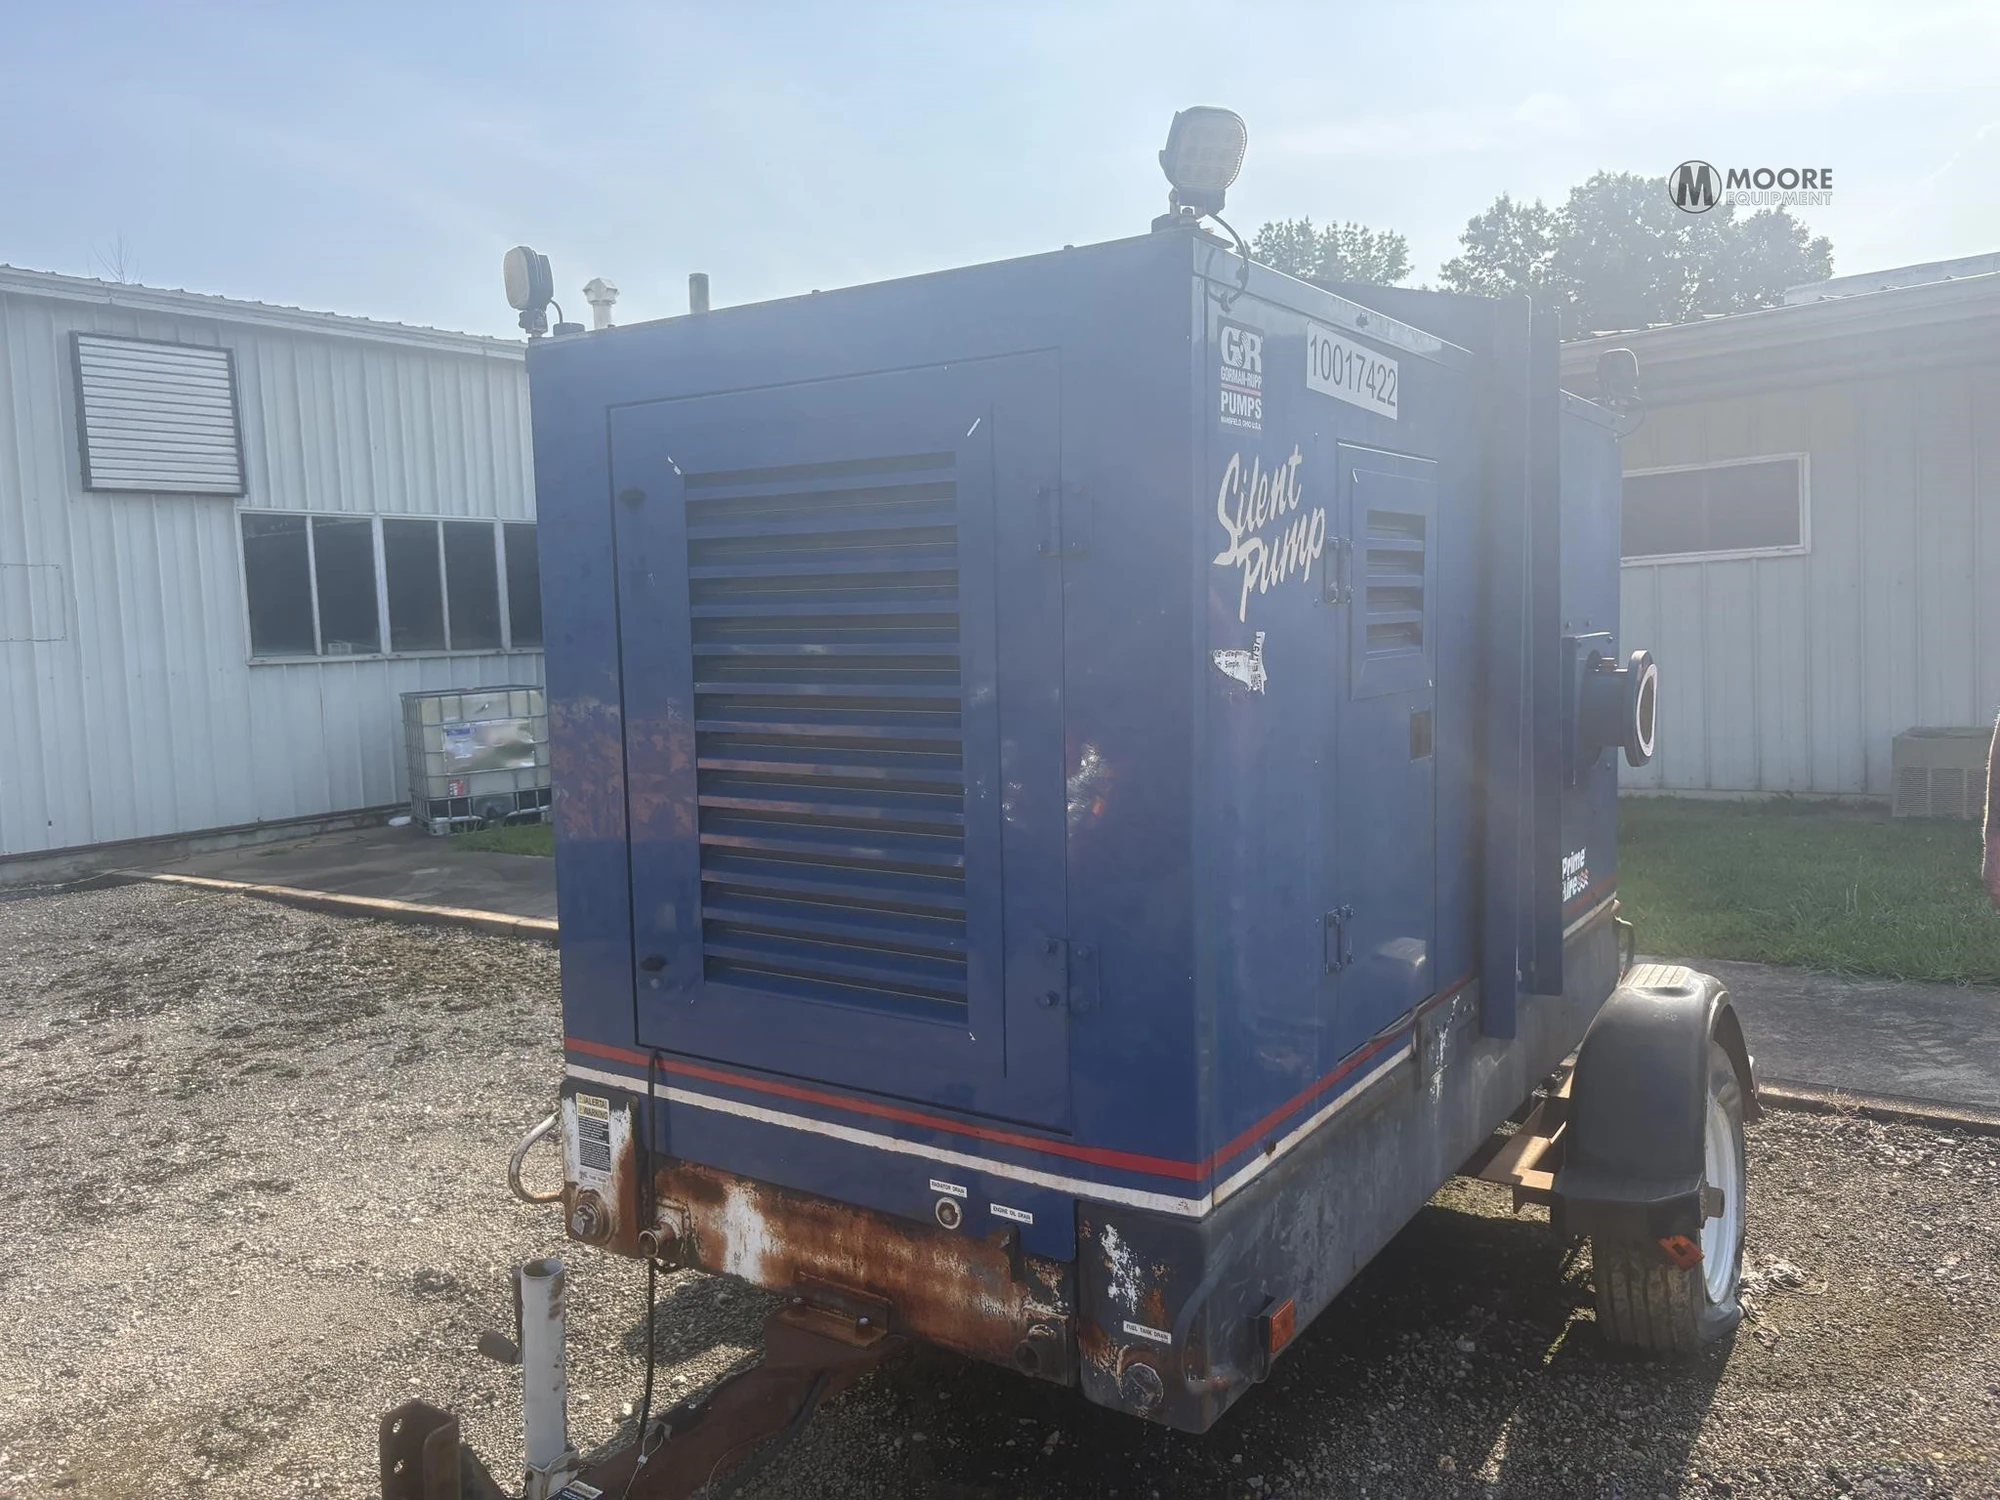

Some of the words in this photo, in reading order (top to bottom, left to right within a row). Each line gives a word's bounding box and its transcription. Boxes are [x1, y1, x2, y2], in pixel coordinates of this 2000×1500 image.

[1220, 366, 1262, 389] GORMAN-RUPP
[1310, 334, 1397, 407] 10017422
[1220, 390, 1262, 419] PUMPS
[1213, 444, 1303, 566] Silent
[1234, 507, 1325, 623] Pump
[1562, 848, 1585, 880] Prime
[584, 1106, 608, 1120] WARNING
[931, 1181, 951, 1191] RADIATOR
[952, 1185, 965, 1195] DRAIN
[993, 1205, 1008, 1215] ENGINE
[1009, 1209, 1017, 1217] OIL
[1017, 1211, 1031, 1220] DRAIN
[1126, 1323, 1138, 1332] FUEL
[1139, 1327, 1152, 1336] TANK
